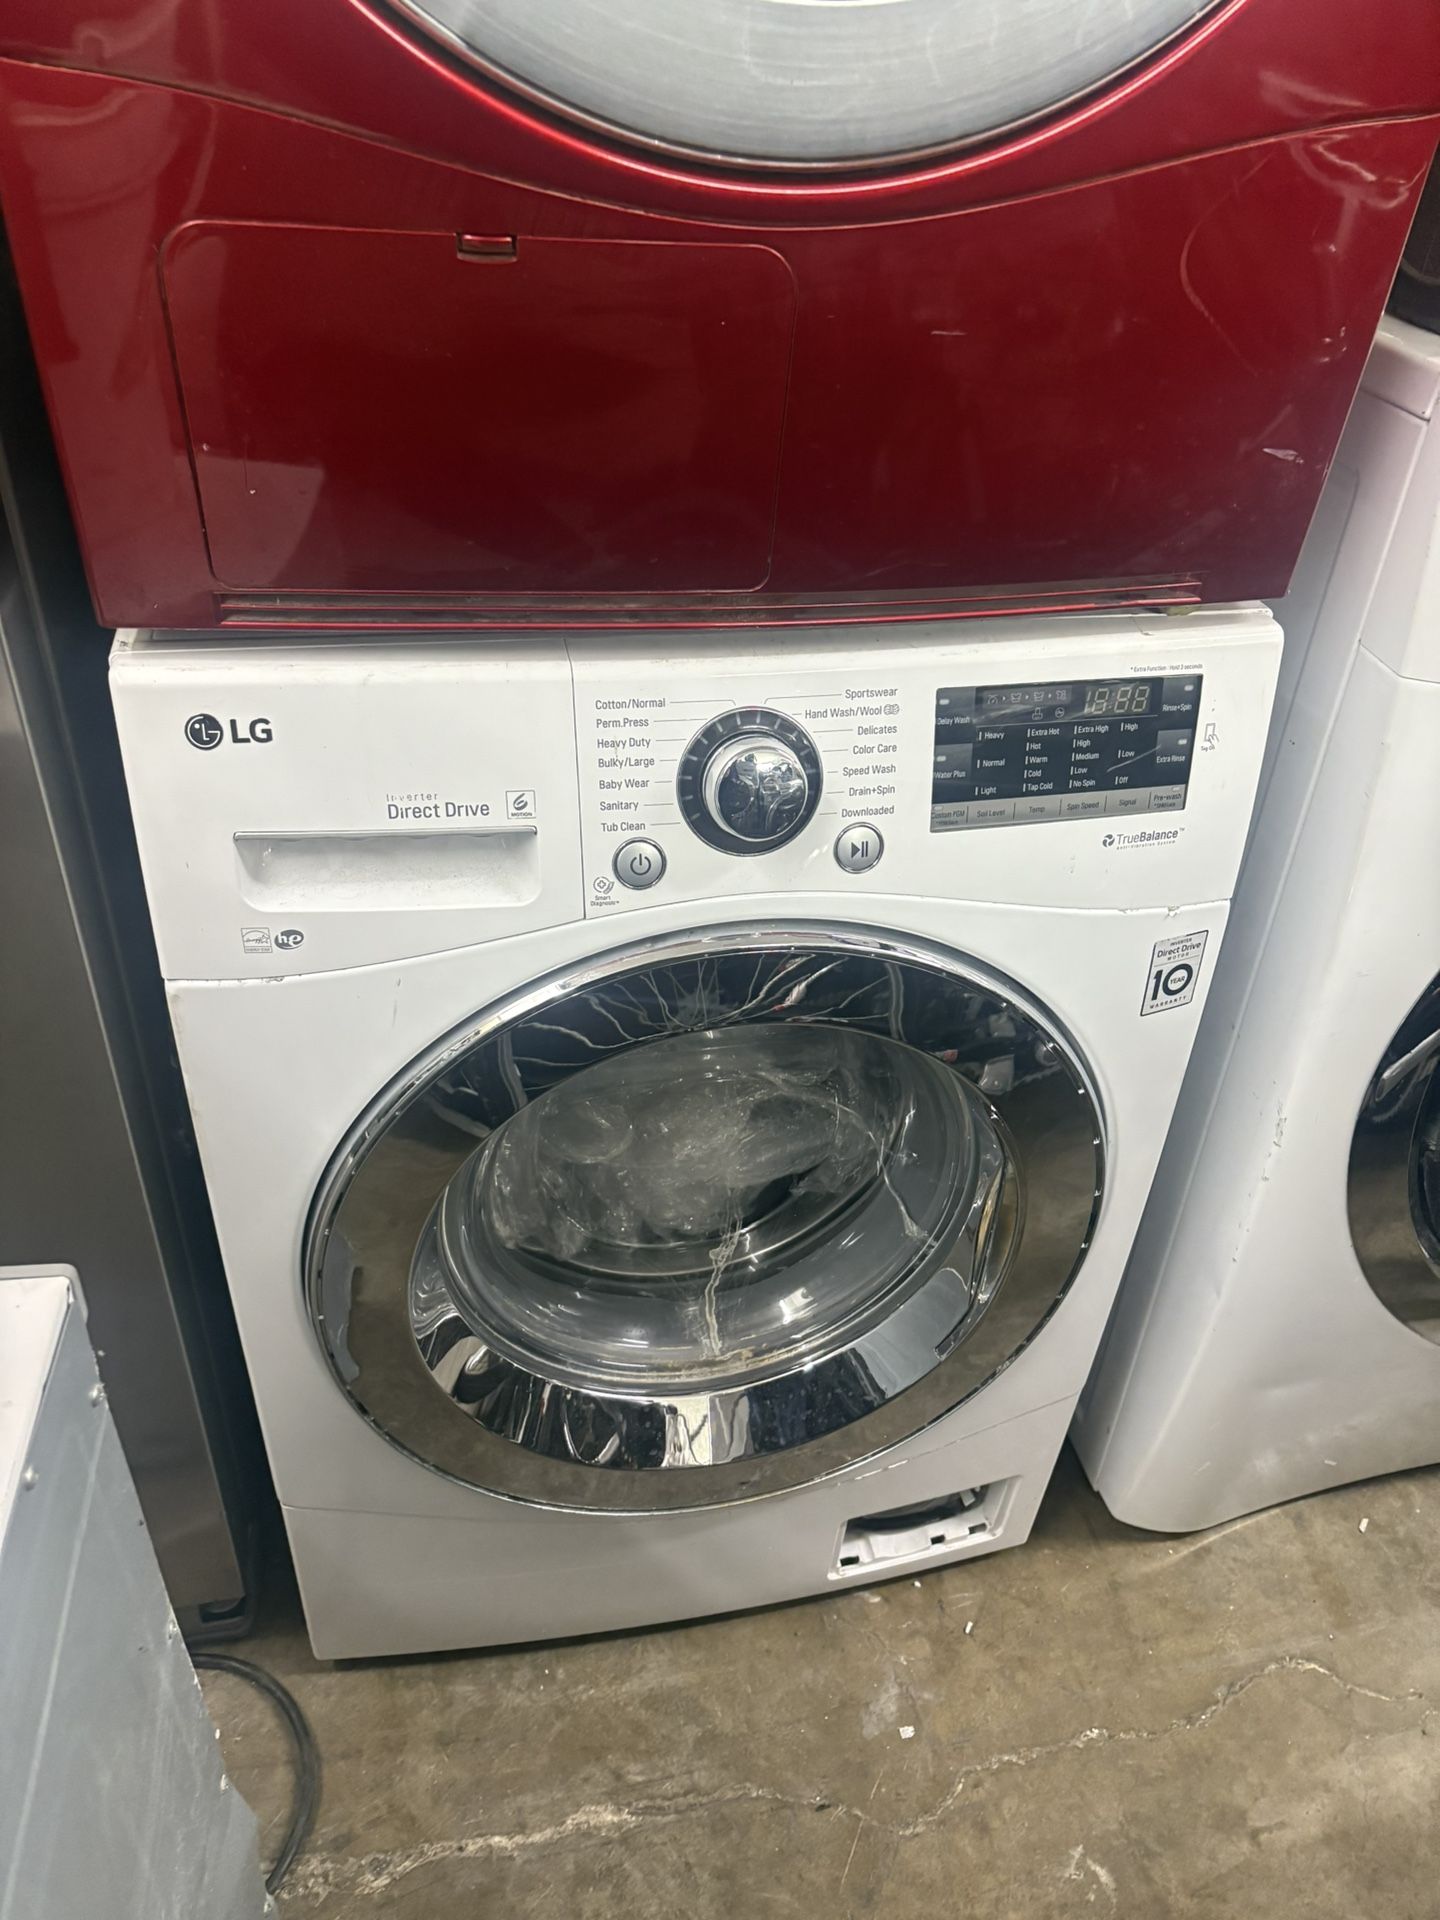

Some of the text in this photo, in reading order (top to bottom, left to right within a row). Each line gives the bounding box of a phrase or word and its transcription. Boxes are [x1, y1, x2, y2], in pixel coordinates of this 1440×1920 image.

[845, 688, 898, 700] Sportswear
[595, 698, 666, 710] Cotton/Normal
[805, 706, 882, 719] Hand Wash/Wool
[596, 718, 649, 728] Perm.Press
[937, 717, 953, 726] Delay
[229, 718, 273, 743] LG
[858, 725, 897, 735] Delicates
[1124, 723, 1138, 731] High
[597, 737, 651, 749] Heavy Duty
[1077, 739, 1090, 747] High
[853, 744, 897, 754] Color Care
[598, 758, 655, 769] Bulky/Large
[983, 759, 1005, 767] Normal
[1030, 756, 1048, 764] Warm
[843, 764, 896, 777] Speed Wash
[599, 778, 649, 790] Baby Wear
[1028, 784, 1038, 792] Tap
[849, 785, 895, 796] Drain+Spin
[981, 786, 996, 795] Light
[388, 802, 490, 819] Direct Drive
[600, 800, 638, 811] Sanitary
[1029, 806, 1045, 814] Temp
[1081, 802, 1099, 810] Speed
[842, 806, 894, 817] Downloaded
[977, 810, 989, 818] Soil
[601, 821, 645, 831] Tub Clean
[1157, 942, 1201, 958] Direct Drive
[1151, 963, 1193, 1001] 10
[1170, 976, 1185, 985] YEAR
[1150, 996, 1186, 1009] WARRANTY
